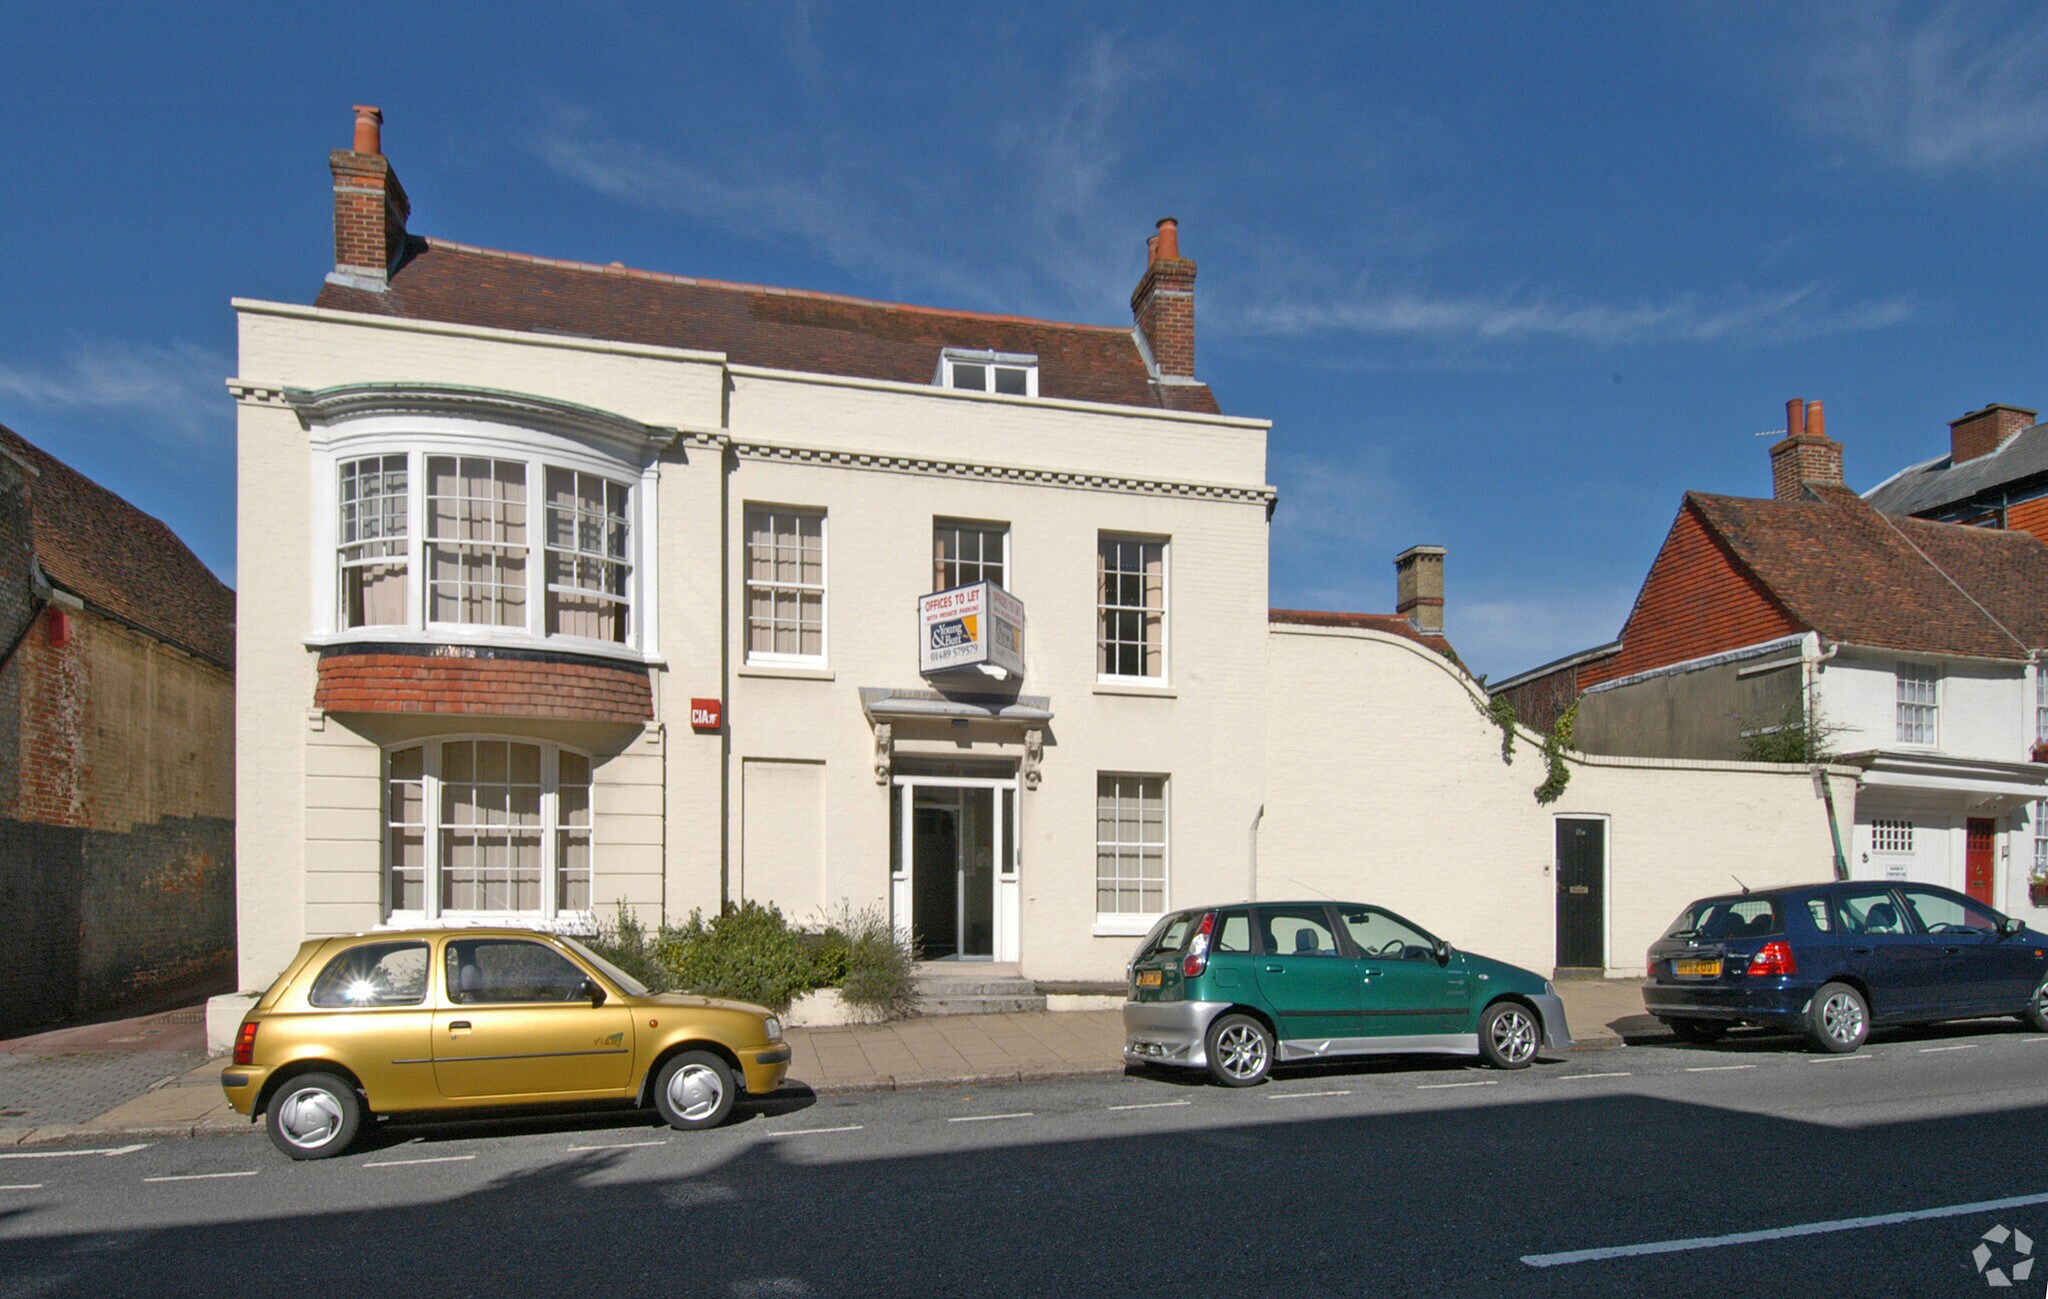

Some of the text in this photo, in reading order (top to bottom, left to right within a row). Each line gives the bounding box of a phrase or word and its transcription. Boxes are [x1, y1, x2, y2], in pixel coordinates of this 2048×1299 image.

[925, 589, 979, 612] OFFICES TO LET
[939, 610, 957, 618] PRIVATE
[959, 605, 979, 613] PARKING
[938, 623, 963, 637] Young
[932, 629, 945, 648] &
[930, 650, 951, 661] 01489
[692, 709, 708, 724] CIA
